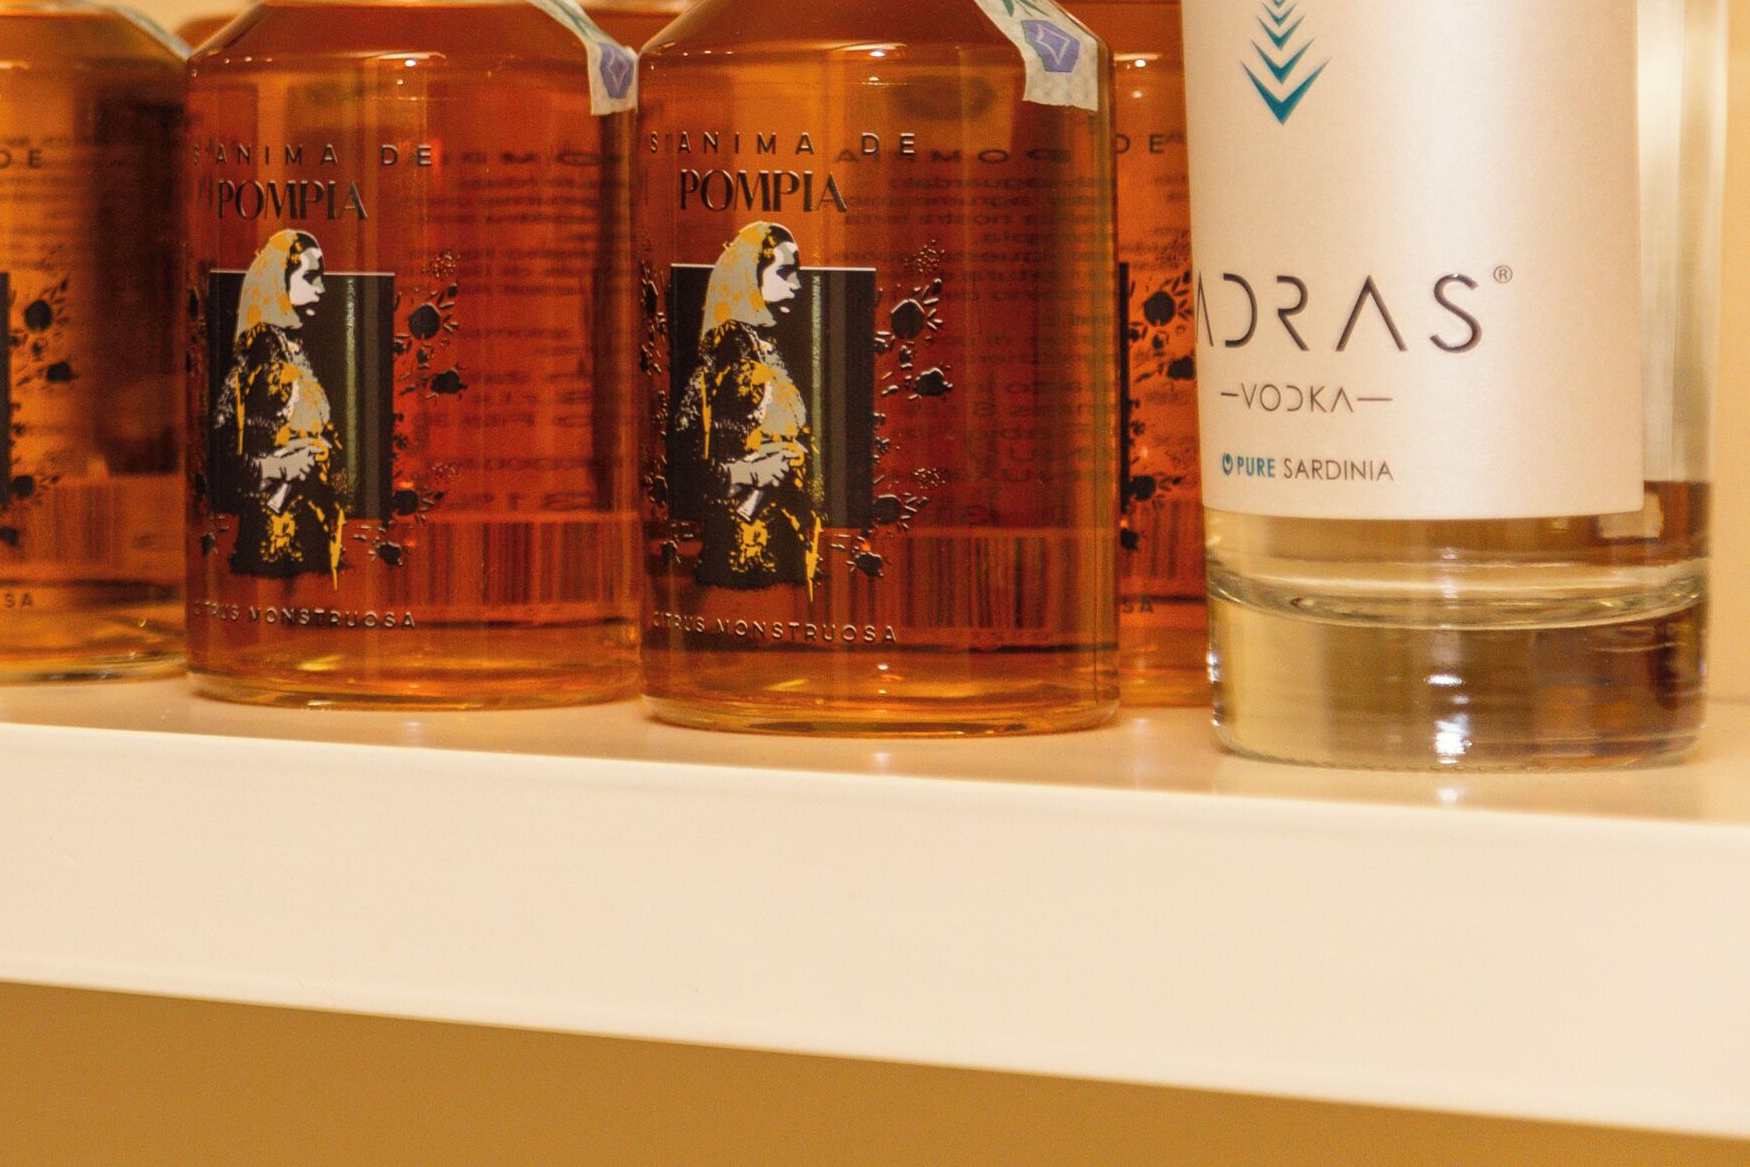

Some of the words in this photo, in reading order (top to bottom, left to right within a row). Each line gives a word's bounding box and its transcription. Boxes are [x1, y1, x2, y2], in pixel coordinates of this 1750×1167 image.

[381, 144, 433, 167] DE
[861, 132, 916, 157] DE
[216, 179, 368, 221] POMPIA
[679, 168, 848, 213] POMPIA
[1236, 457, 1276, 478] PURE
[1283, 458, 1394, 481] SARDINIA
[249, 606, 416, 629] MONSTRUOSA
[716, 618, 897, 644] MONSTRUOSA
